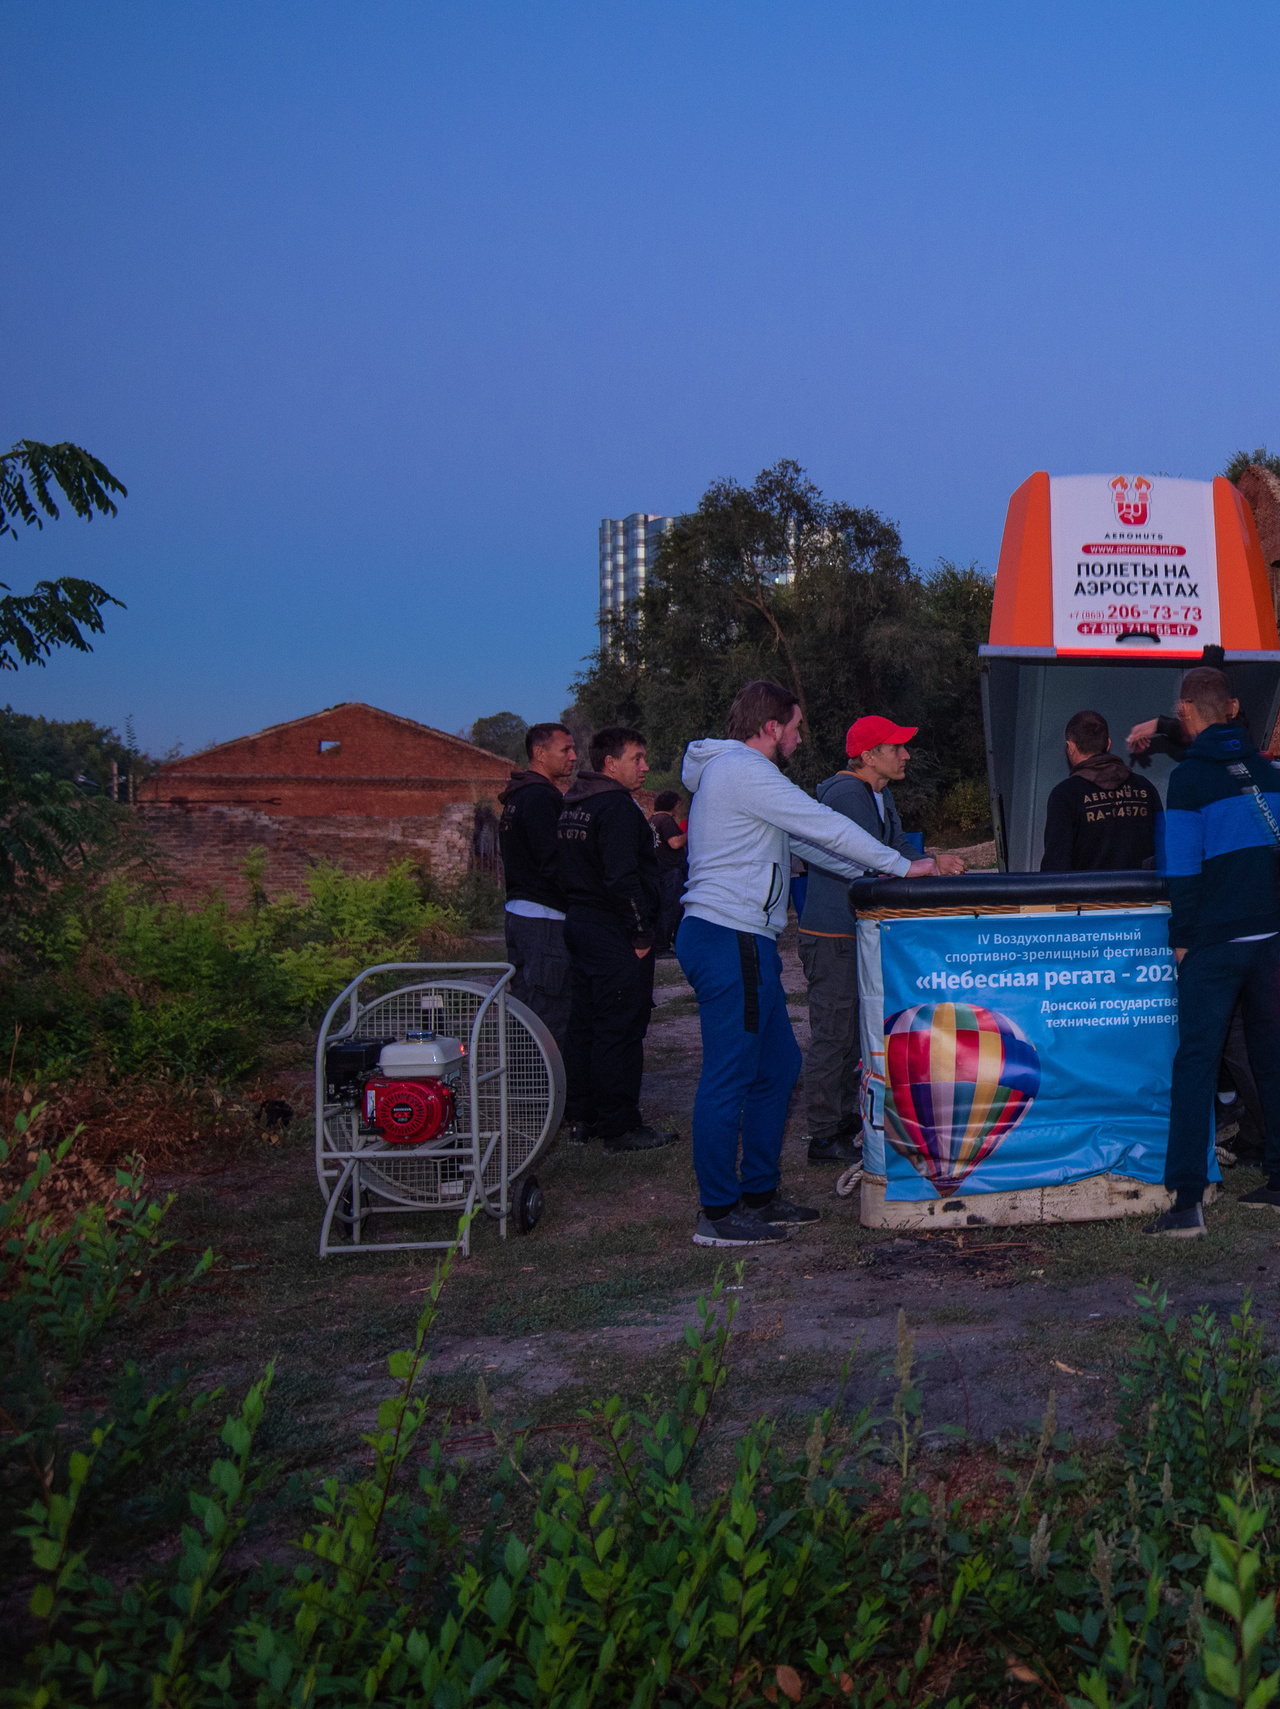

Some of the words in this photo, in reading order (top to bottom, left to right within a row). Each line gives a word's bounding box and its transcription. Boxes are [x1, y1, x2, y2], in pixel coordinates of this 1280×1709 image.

[1104, 532, 1164, 540] AERONUTS
[1090, 545, 1179, 556] www.aeronuts.info
[1076, 561, 1158, 579] ПОЛЕТЫ
[1164, 563, 1191, 579] НА
[1073, 580, 1200, 598] АЭРОСТАТАХ
[1107, 604, 1203, 622] 206-73-73
[1081, 623, 1097, 635] +7
[977, 933, 990, 945] IV
[993, 928, 1142, 947] Воздухоплавательный
[945, 946, 1100, 965] спортивно-зрелищный
[1103, 946, 1173, 961] фестиваль
[916, 968, 1039, 990] «Небесная
[1045, 970, 1116, 990] регата
[1136, 964, 1178, 983] 202
[1040, 998, 1097, 1014] Донской
[1046, 1012, 1129, 1028] технический
